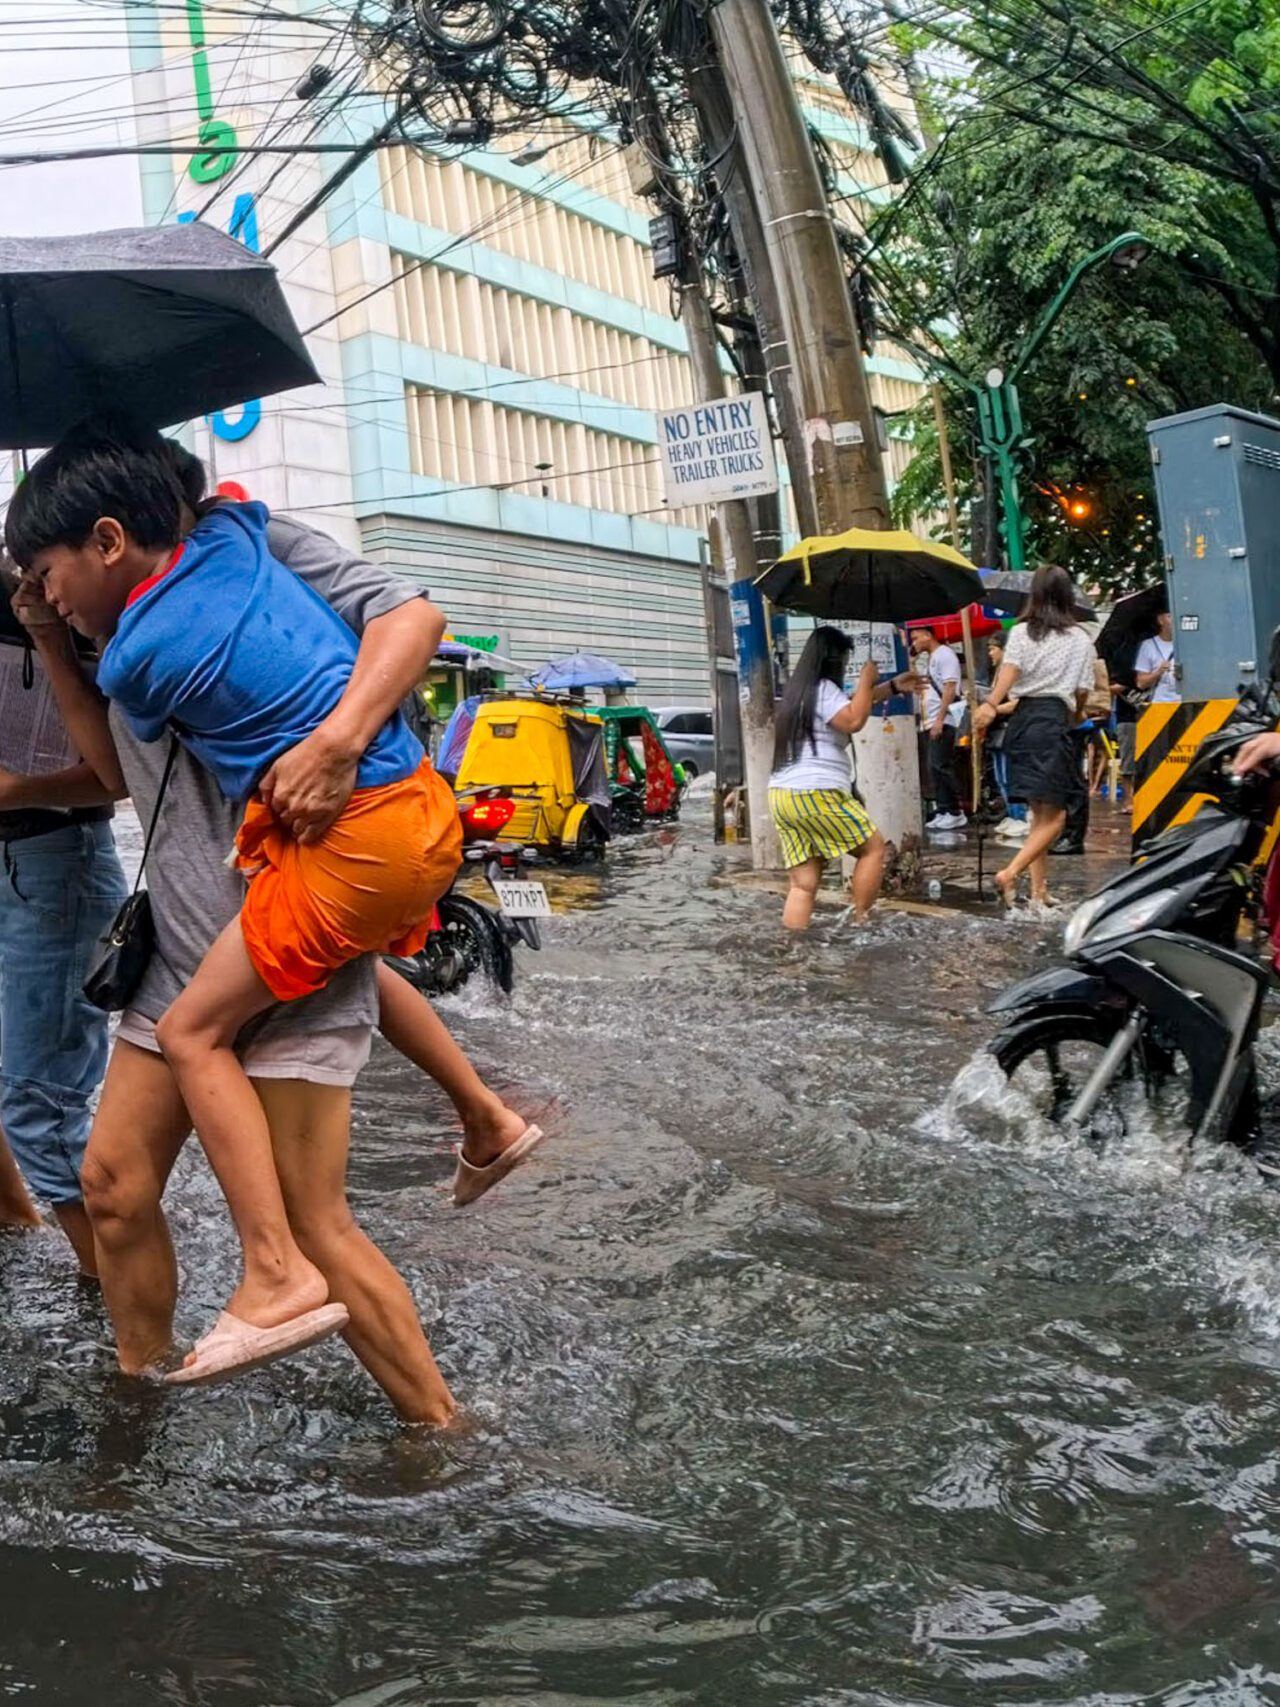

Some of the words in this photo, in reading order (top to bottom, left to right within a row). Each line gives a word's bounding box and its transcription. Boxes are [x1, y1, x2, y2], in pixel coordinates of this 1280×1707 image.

[663, 413, 690, 442] NO
[694, 400, 753, 436] ENTRY
[668, 438, 703, 464] HEAVY
[672, 459, 720, 484] TRAILER
[720, 451, 764, 475] TRUCKS
